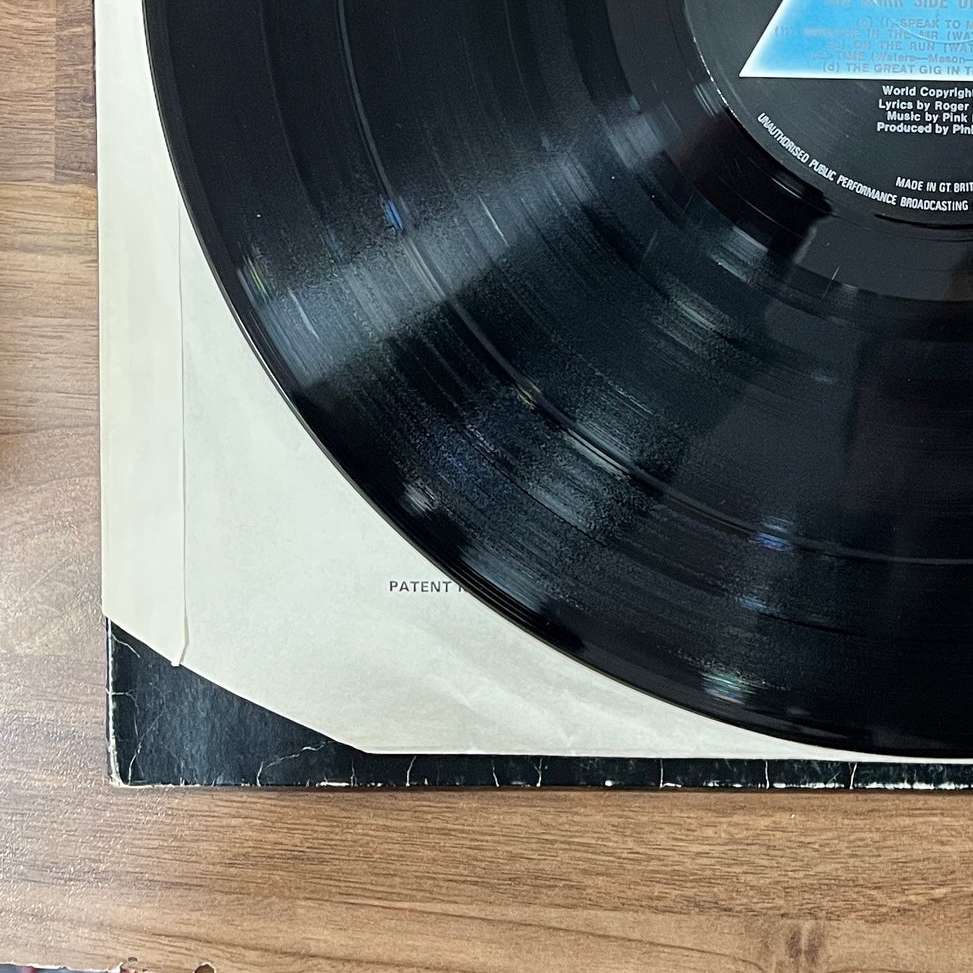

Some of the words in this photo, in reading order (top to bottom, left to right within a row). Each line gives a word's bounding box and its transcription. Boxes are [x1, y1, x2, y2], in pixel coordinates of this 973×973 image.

[900, 19, 939, 28] SPEAK
[945, 20, 960, 29] TO
[889, 30, 911, 39] THE
[879, 41, 902, 50] THE
[910, 43, 935, 52] RUN
[823, 63, 840, 73] (d)
[846, 63, 870, 72] THE
[874, 64, 915, 73] GREAT
[919, 65, 941, 74] GIG
[947, 66, 960, 75] IN
[882, 85, 916, 96] World
[878, 99, 913, 110] Lyrics
[916, 100, 930, 111] by
[934, 101, 969, 112] Roger
[887, 111, 921, 121] Music
[925, 112, 939, 123] by
[942, 113, 967, 122] Pink
[877, 122, 932, 133] Produced
[935, 124, 949, 135] by
[757, 112, 810, 164] UNAUTHORISED
[808, 158, 837, 182] PUBLIC
[837, 174, 897, 206] PERFORMANCE
[900, 197, 968, 211] BROADCASTING
[895, 177, 923, 191] MADE
[926, 180, 936, 192] IN
[390, 581, 452, 593] PATENT
